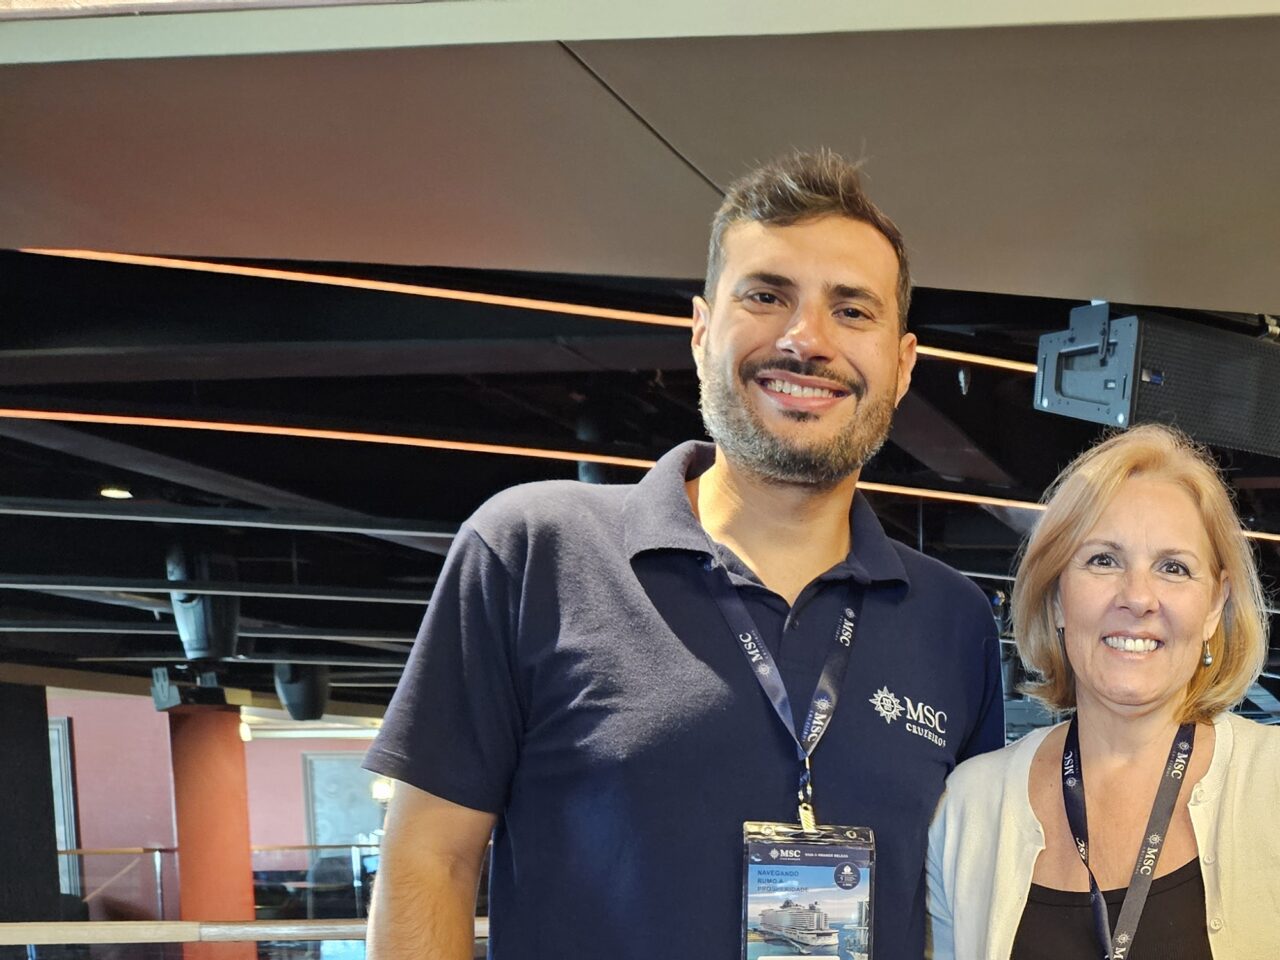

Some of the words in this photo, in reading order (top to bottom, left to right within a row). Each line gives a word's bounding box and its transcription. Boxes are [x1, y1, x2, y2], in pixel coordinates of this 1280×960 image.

[739, 632, 762, 662] MSC
[839, 619, 854, 647] MSC
[807, 712, 828, 742] MSC
[904, 696, 947, 734] MSC
[906, 722, 946, 748] CRUZEIROS
[1064, 750, 1074, 775] MSC
[1171, 752, 1188, 779] MSC
[780, 849, 800, 858] MSC
[1140, 847, 1158, 875] MSC
